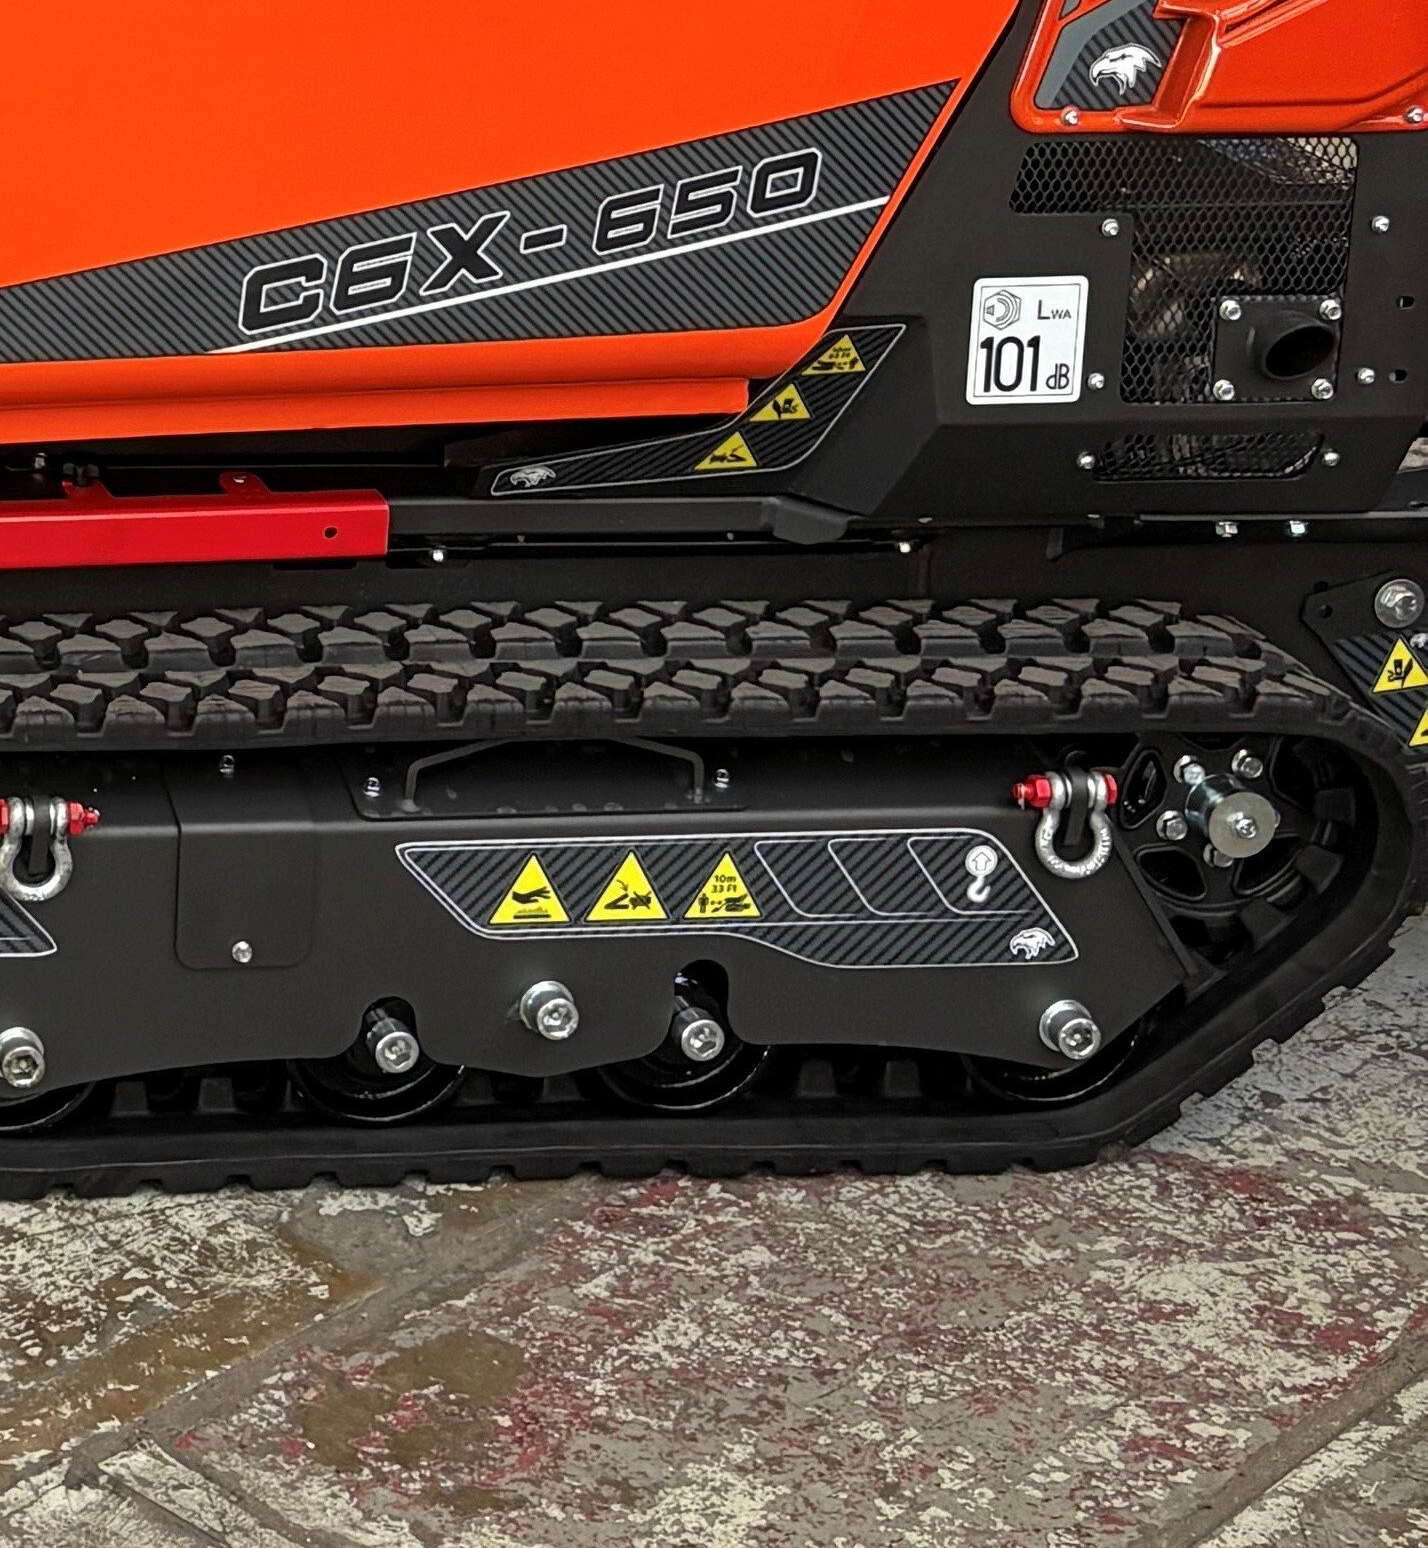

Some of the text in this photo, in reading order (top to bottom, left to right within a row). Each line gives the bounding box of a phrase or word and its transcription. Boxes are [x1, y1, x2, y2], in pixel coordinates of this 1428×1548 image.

[238, 147, 821, 335] C6X-650
[980, 335, 1070, 393] 101 dB
[715, 874, 737, 883] 10m
